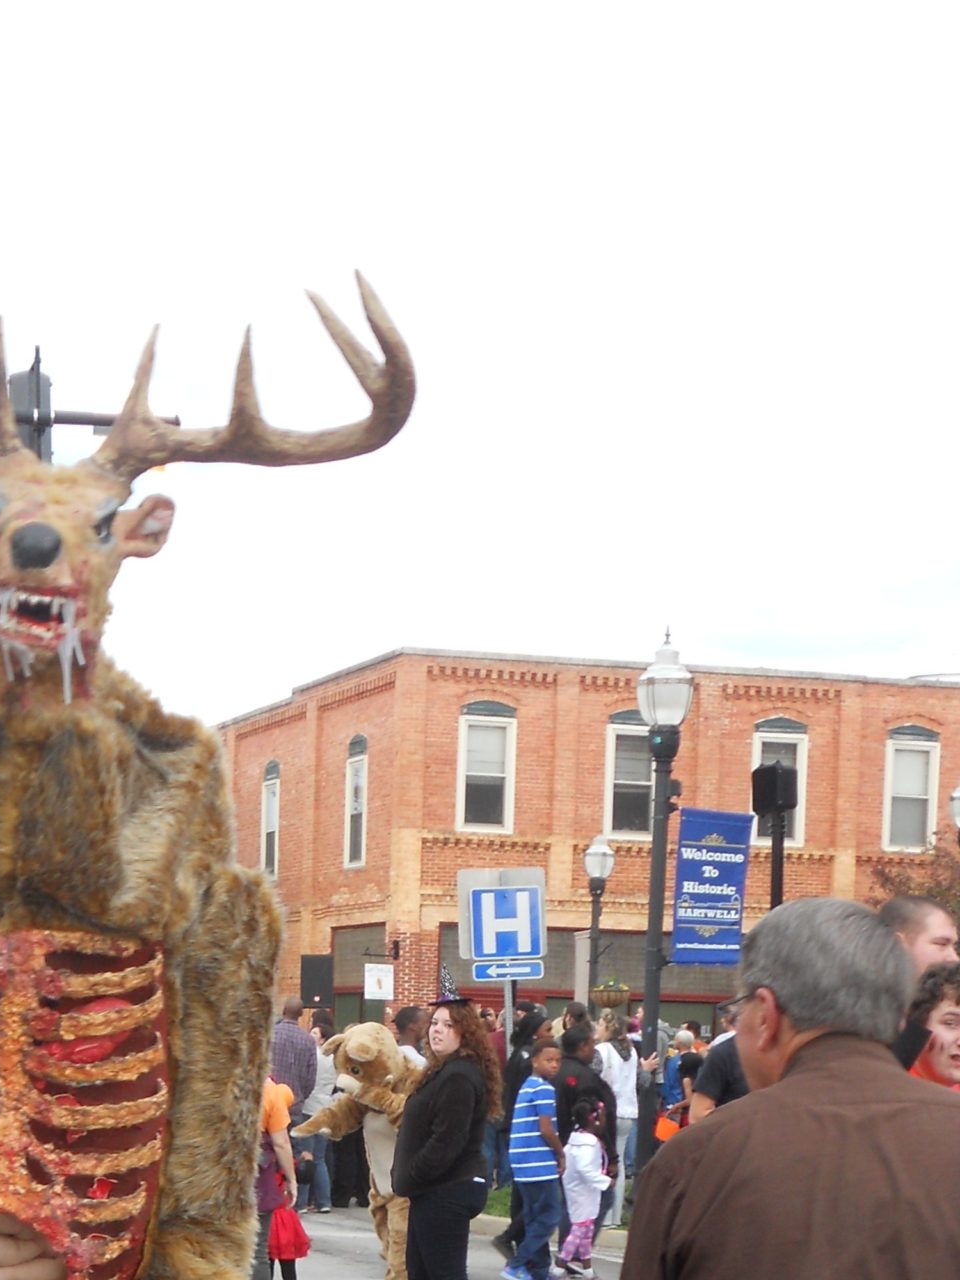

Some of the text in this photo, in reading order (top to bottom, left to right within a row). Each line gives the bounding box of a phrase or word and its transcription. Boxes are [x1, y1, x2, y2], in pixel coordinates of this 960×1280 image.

[680, 847, 745, 863] Welcome
[701, 865, 720, 878] To
[682, 881, 737, 896] Historic
[677, 908, 739, 919] HARTWELL
[481, 891, 532, 955] H
